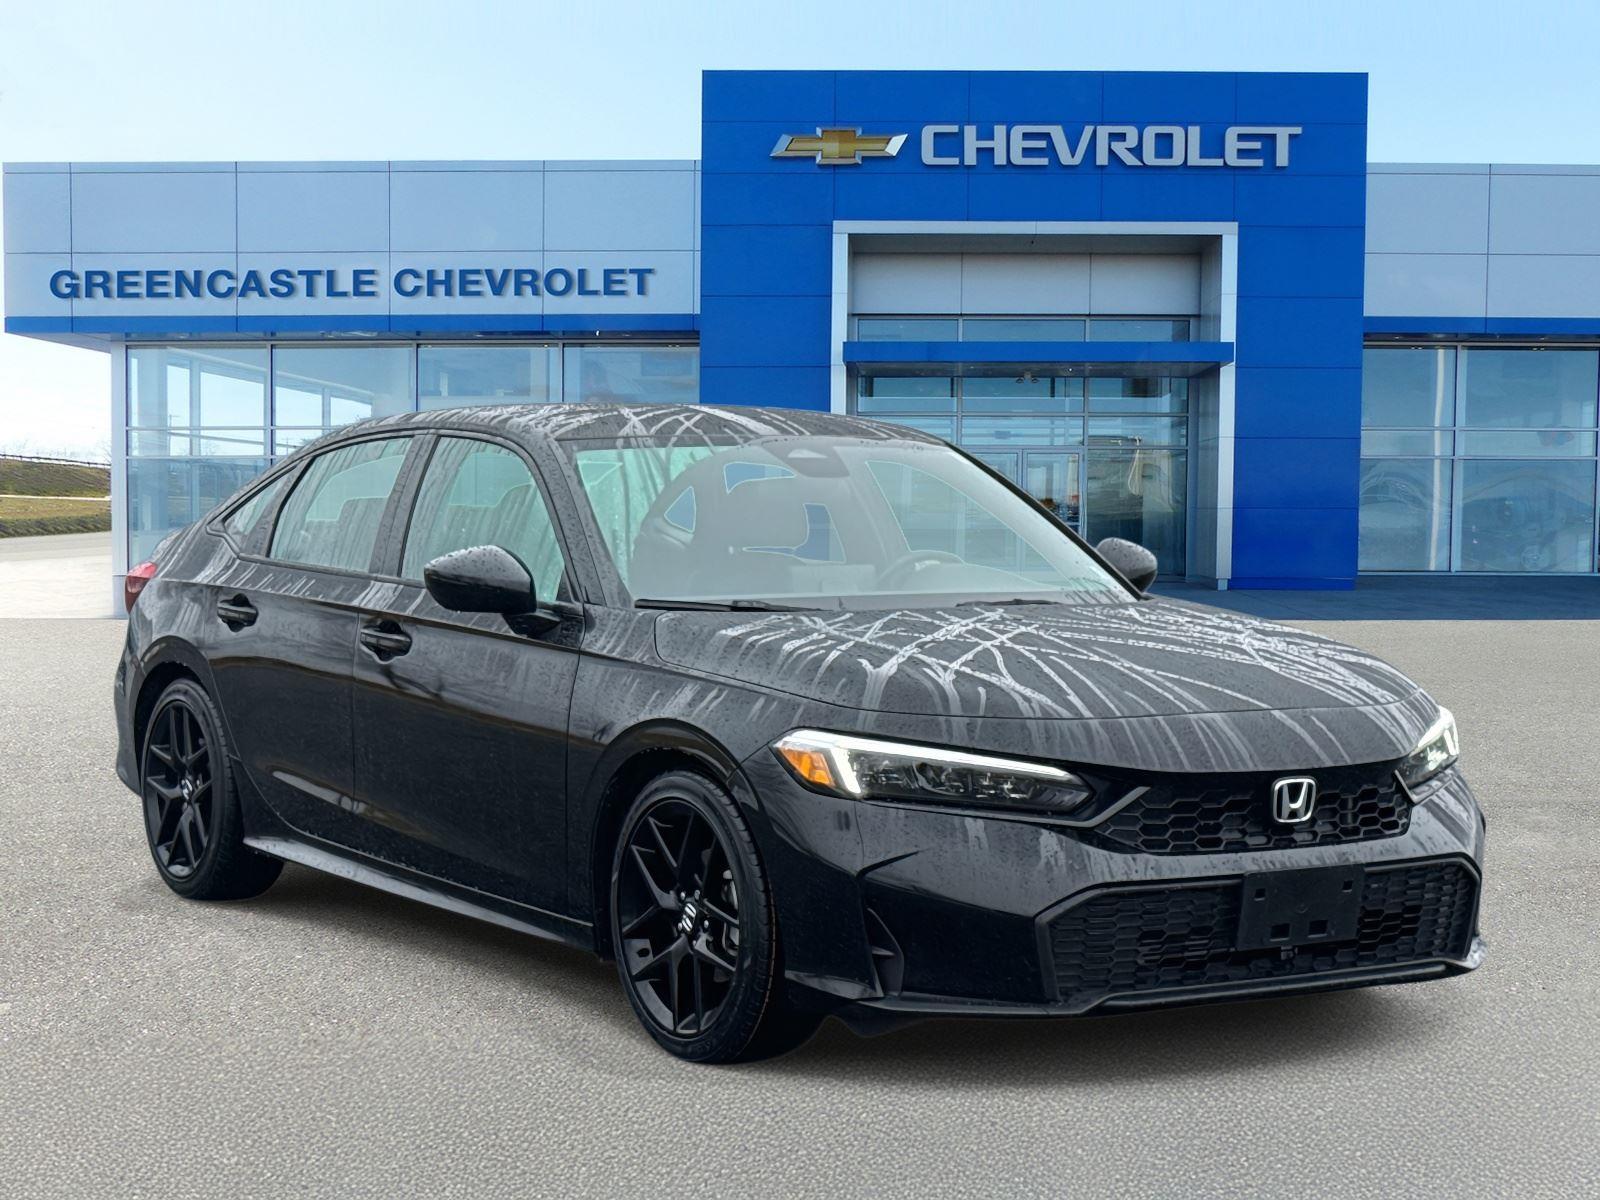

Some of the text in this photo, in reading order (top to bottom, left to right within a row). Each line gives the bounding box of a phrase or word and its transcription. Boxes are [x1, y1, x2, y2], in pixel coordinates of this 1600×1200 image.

[921, 124, 1303, 167] CHEVROLET
[50, 267, 655, 299] GREENCASTLE CHEVROLET
